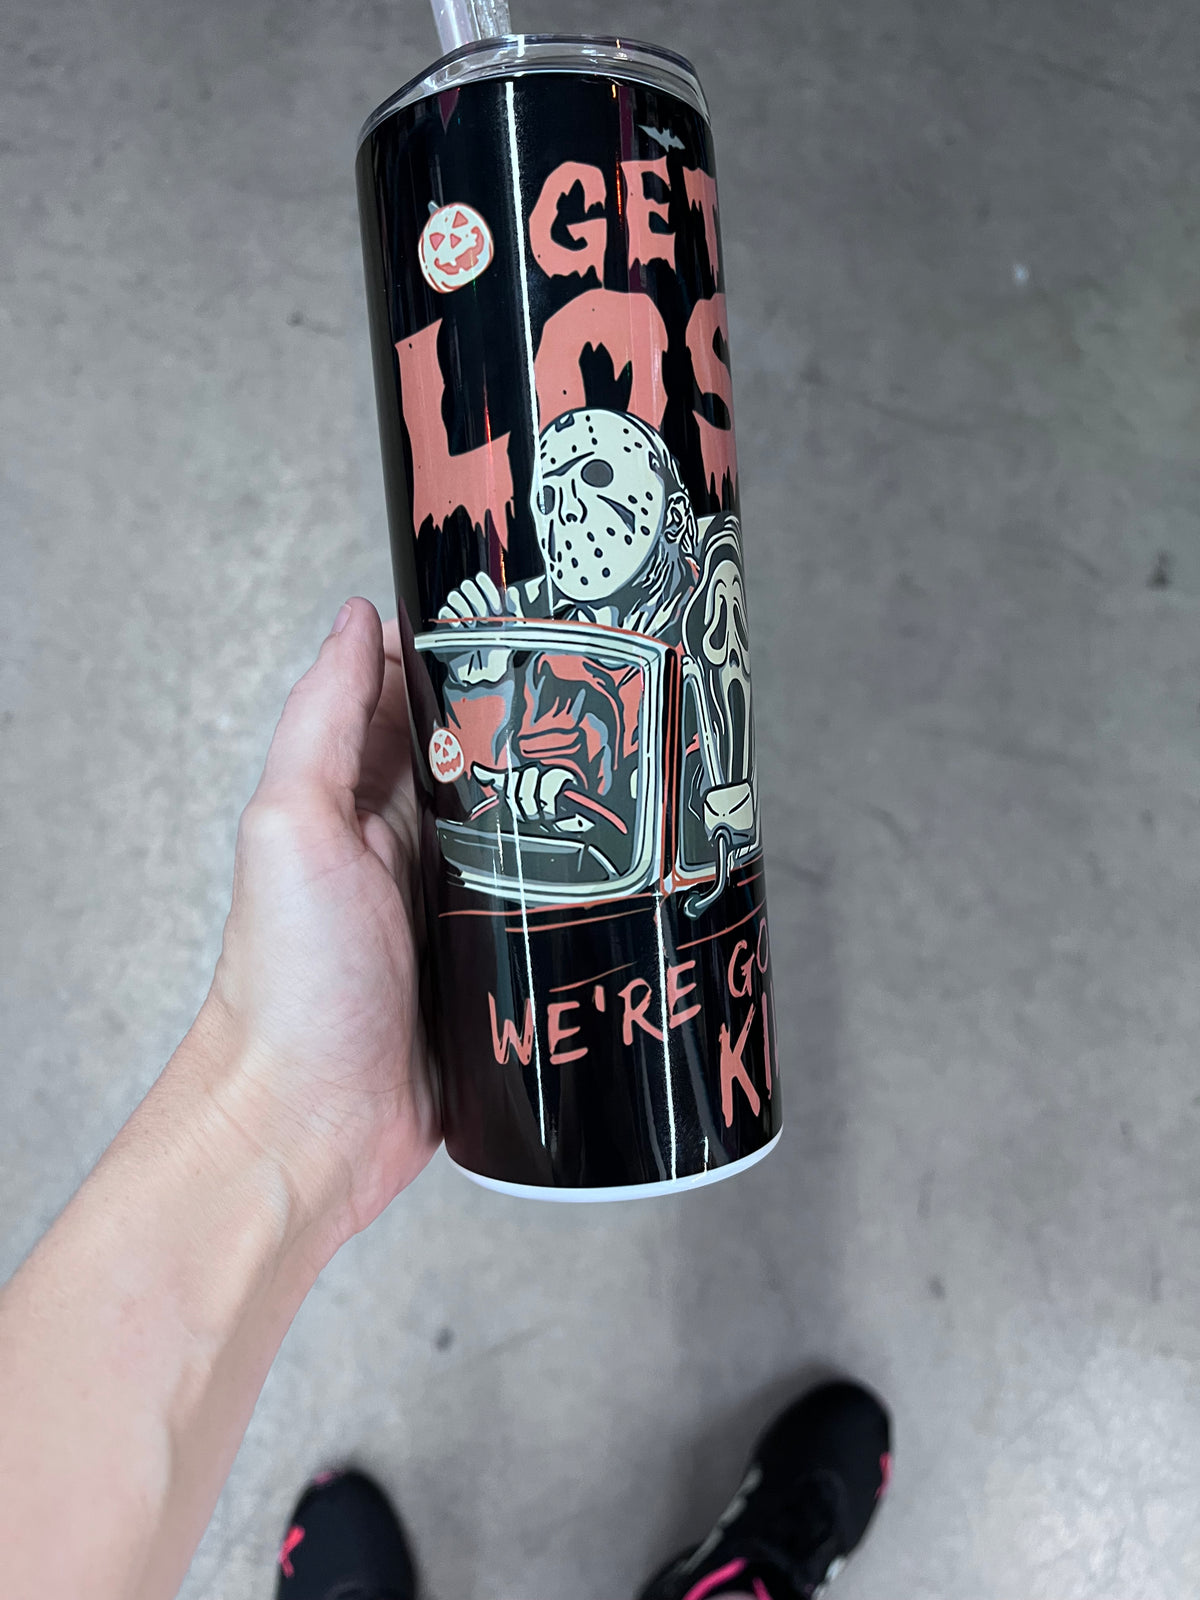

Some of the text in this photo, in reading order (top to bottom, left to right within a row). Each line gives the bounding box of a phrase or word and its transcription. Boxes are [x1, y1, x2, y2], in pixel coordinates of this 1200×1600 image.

[529, 156, 718, 288] GET
[488, 960, 701, 1065] WE'RE
[719, 980, 780, 1128] KI
